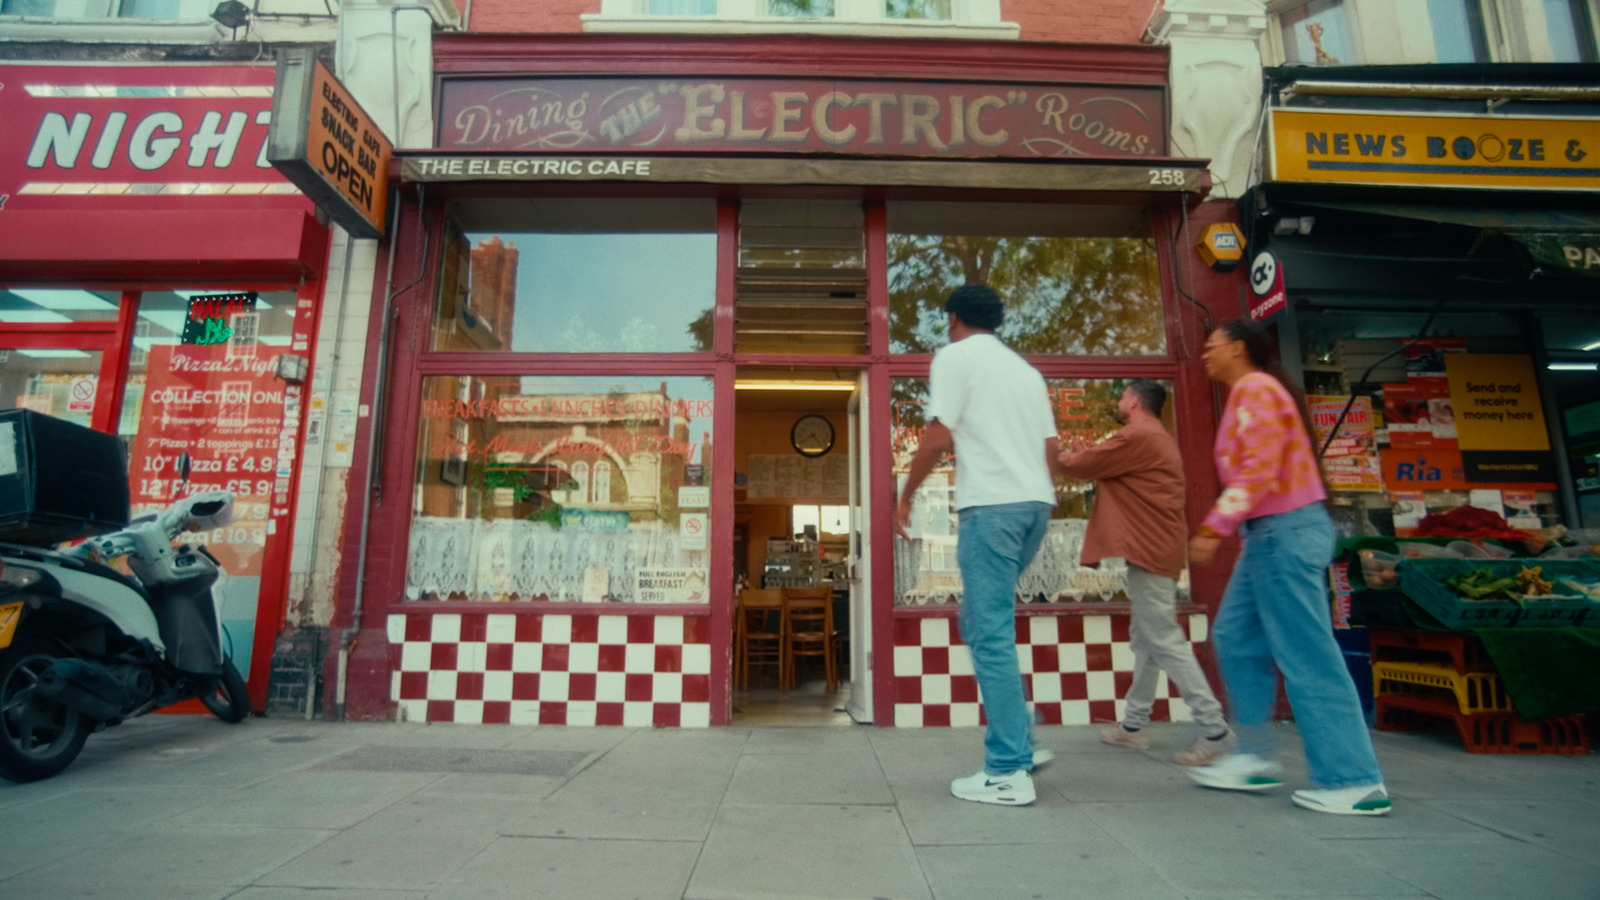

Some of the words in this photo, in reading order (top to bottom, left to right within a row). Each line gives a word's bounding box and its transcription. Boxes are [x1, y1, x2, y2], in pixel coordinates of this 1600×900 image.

[323, 80, 359, 132] ELECTRIC
[363, 129, 381, 158] CAFE
[454, 91, 590, 145] Dining
[599, 91, 661, 147] THE
[322, 106, 355, 158] SNACK
[358, 145, 376, 180] BAR
[1306, 132, 1407, 158] NEWS
[1426, 135, 1545, 163] BOOZE
[1564, 140, 1588, 162] &
[322, 141, 373, 213] OPEN
[419, 160, 463, 175] THE
[468, 160, 583, 176] ELECTRIC
[587, 160, 651, 176] CAFE
[1148, 169, 1185, 186] 258
[1562, 246, 1600, 269] PA
[190, 299, 246, 320] HALAL
[1250, 292, 1284, 320] payzone
[169, 354, 280, 377] Pizza2Nigh
[150, 390, 250, 404] COLLECTION
[253, 391, 285, 404] ONL
[1465, 382, 1496, 393] Send
[1498, 382, 1522, 393] and
[422, 399, 530, 419] BREAKFASTS
[540, 399, 626, 418] LUNCHES
[634, 398, 714, 419] DINNERS
[1474, 397, 1519, 407] receive
[1313, 412, 1338, 427] FUN
[1463, 411, 1504, 422] money
[1506, 410, 1535, 420] here
[160, 438, 189, 448] Pizza
[207, 438, 254, 451] toppings
[1397, 457, 1442, 482] Ria
[638, 579, 684, 589] BREAKFAST
